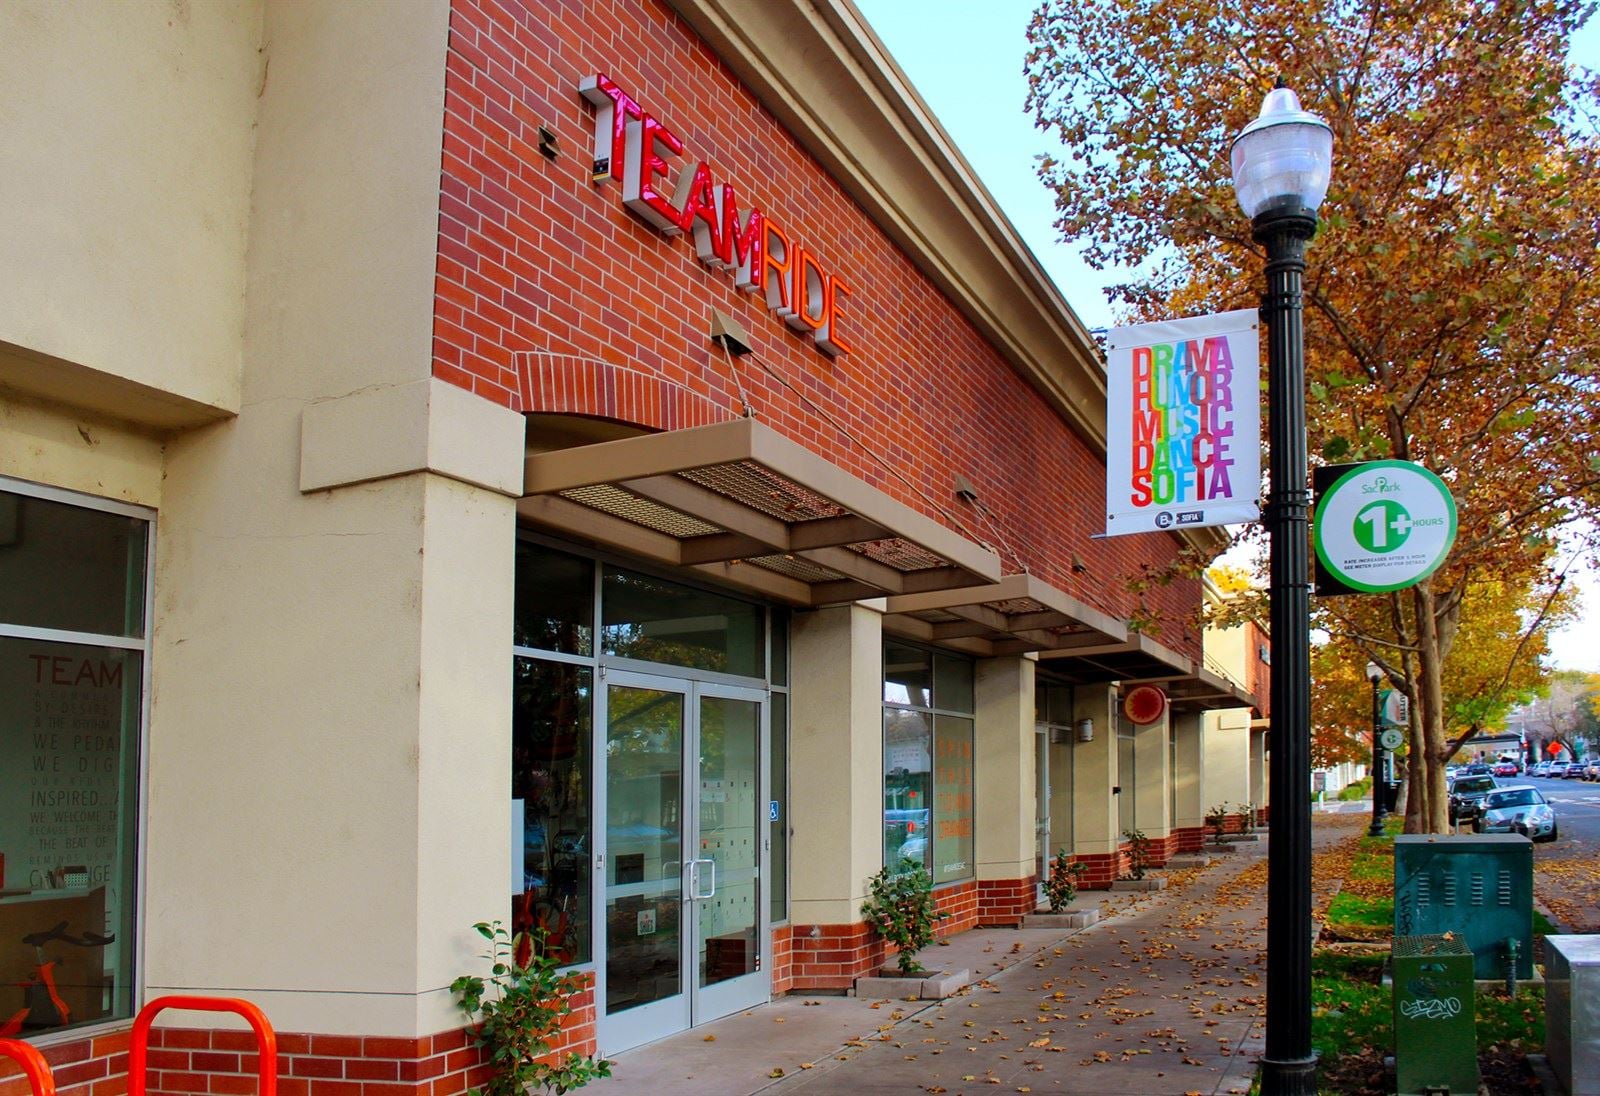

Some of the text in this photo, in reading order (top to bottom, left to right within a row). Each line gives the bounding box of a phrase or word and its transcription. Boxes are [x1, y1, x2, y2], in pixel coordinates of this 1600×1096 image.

[1132, 335, 1234, 383] DRAMA
[1132, 368, 1233, 412] HUMOR
[1132, 403, 1234, 442] MUSIC
[1132, 435, 1234, 477] DANCE
[1131, 465, 1234, 507] SOFIA
[1412, 518, 1444, 527] HOURS
[28, 654, 123, 690] TEAM
[33, 733, 58, 750] WE
[32, 756, 113, 773] WE DIG
[30, 811, 45, 823] WE
[54, 810, 101, 823] WELCOME
[39, 836, 107, 851] THE BEAT OF
